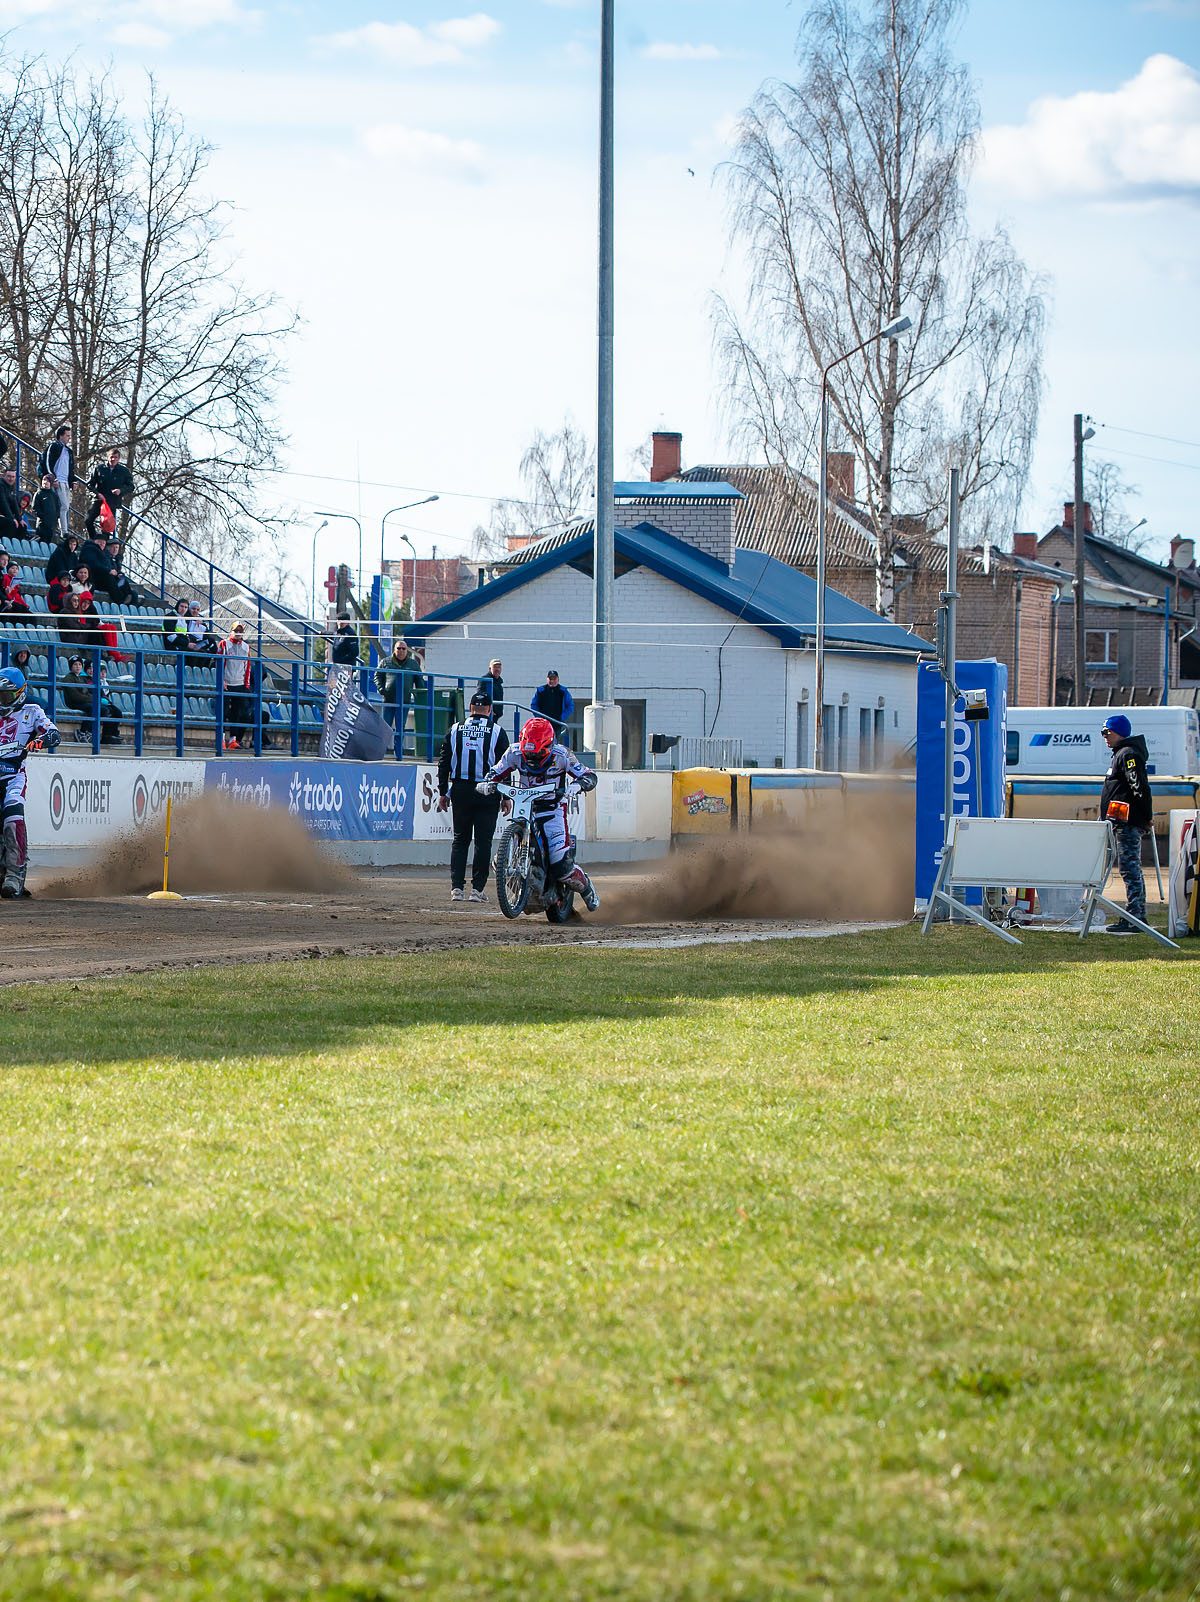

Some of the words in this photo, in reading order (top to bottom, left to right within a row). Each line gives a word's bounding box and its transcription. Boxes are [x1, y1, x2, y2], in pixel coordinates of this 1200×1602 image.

[1052, 733, 1091, 743] SIGMA
[68, 779, 112, 814] OPTIBET
[303, 776, 343, 812] trodo
[371, 779, 407, 813] trodo
